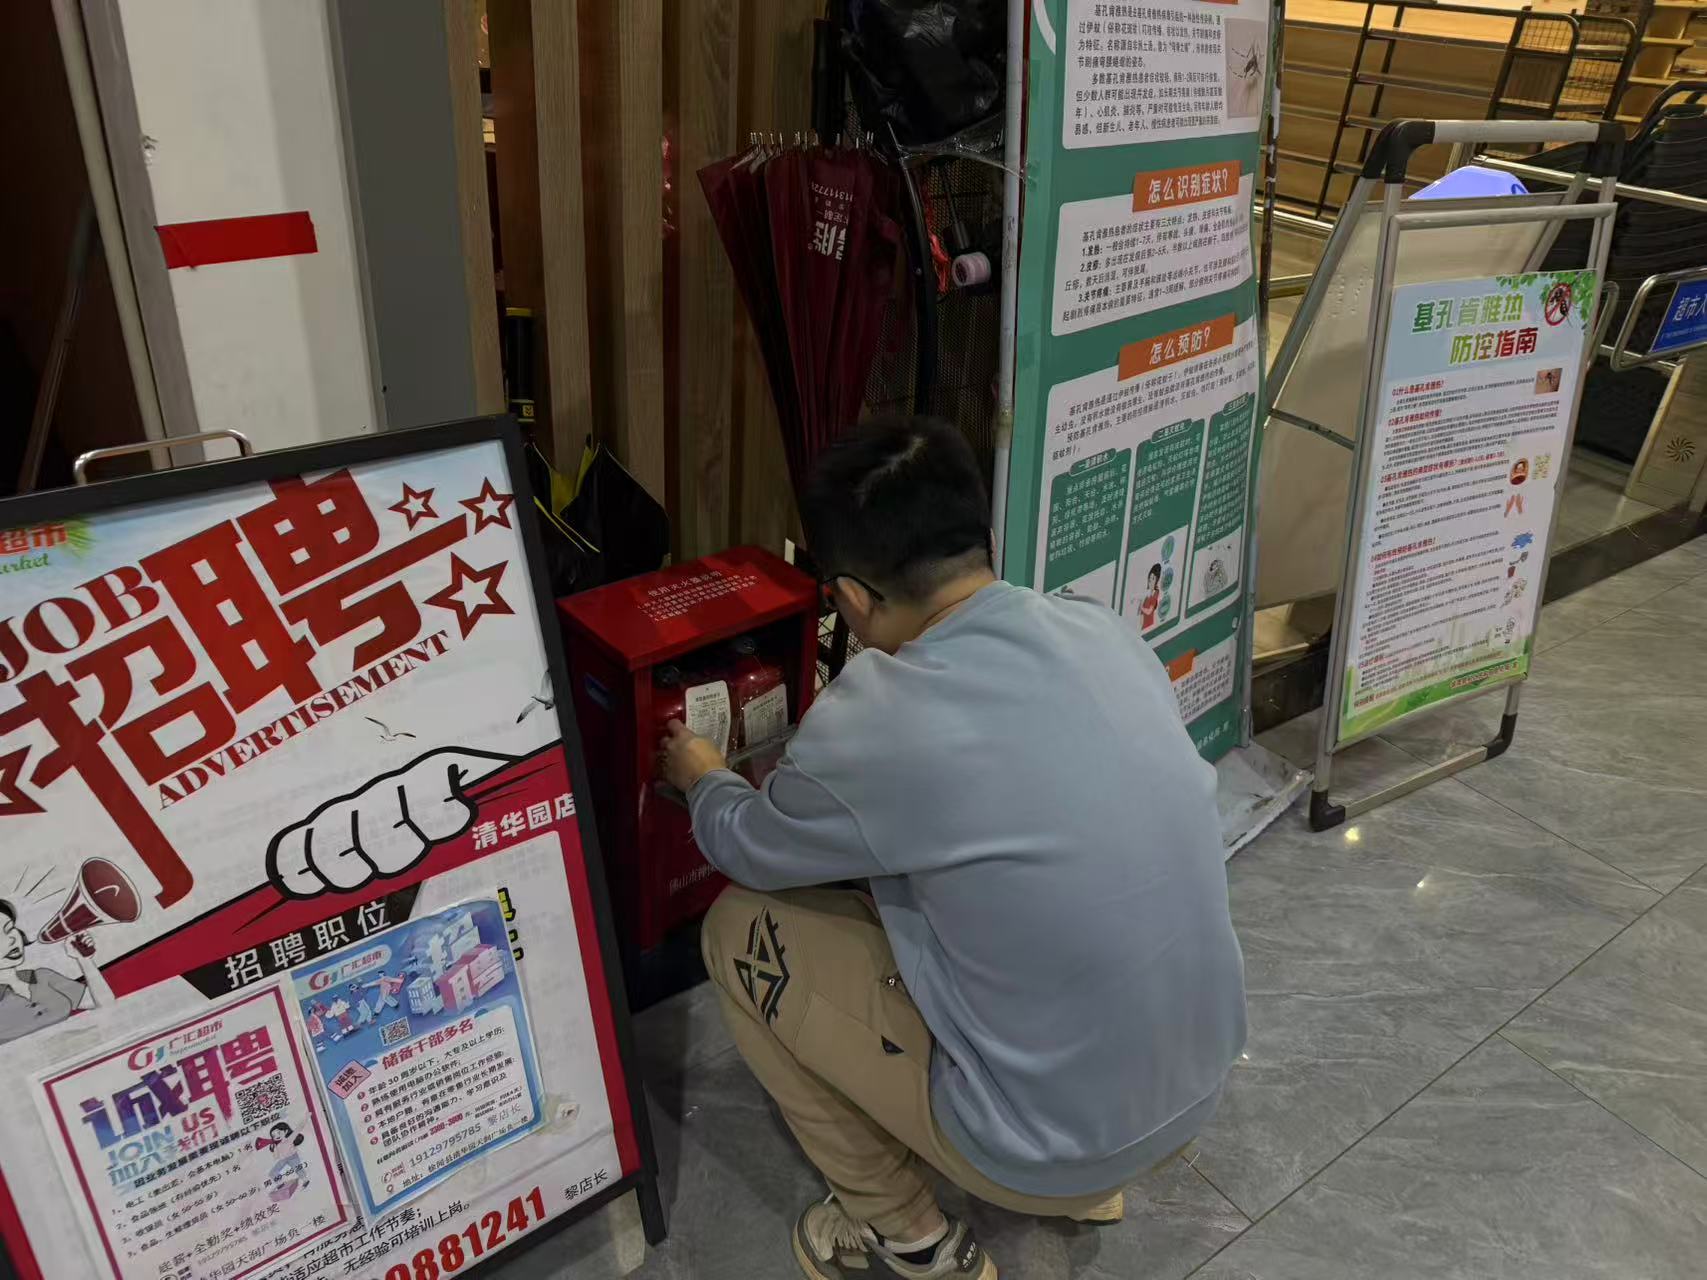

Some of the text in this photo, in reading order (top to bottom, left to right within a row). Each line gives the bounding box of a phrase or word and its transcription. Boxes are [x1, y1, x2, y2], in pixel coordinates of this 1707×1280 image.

[1412, 292, 1524, 333] 基孔肯雅热
[1449, 327, 1538, 365] 防控指南
[0, 468, 469, 908] 招聘
[159, 630, 449, 810] ADVERTISEMENT
[472, 793, 576, 850] 清华园店
[224, 899, 393, 989] 招聘职位
[168, 1020, 223, 1050] 广汇超市
[382, 1017, 474, 1070] 储备干部多名
[78, 1025, 279, 1149] 诚聘
[106, 1107, 216, 1170] JOIN US
[564, 1168, 609, 1200] 黎店长
